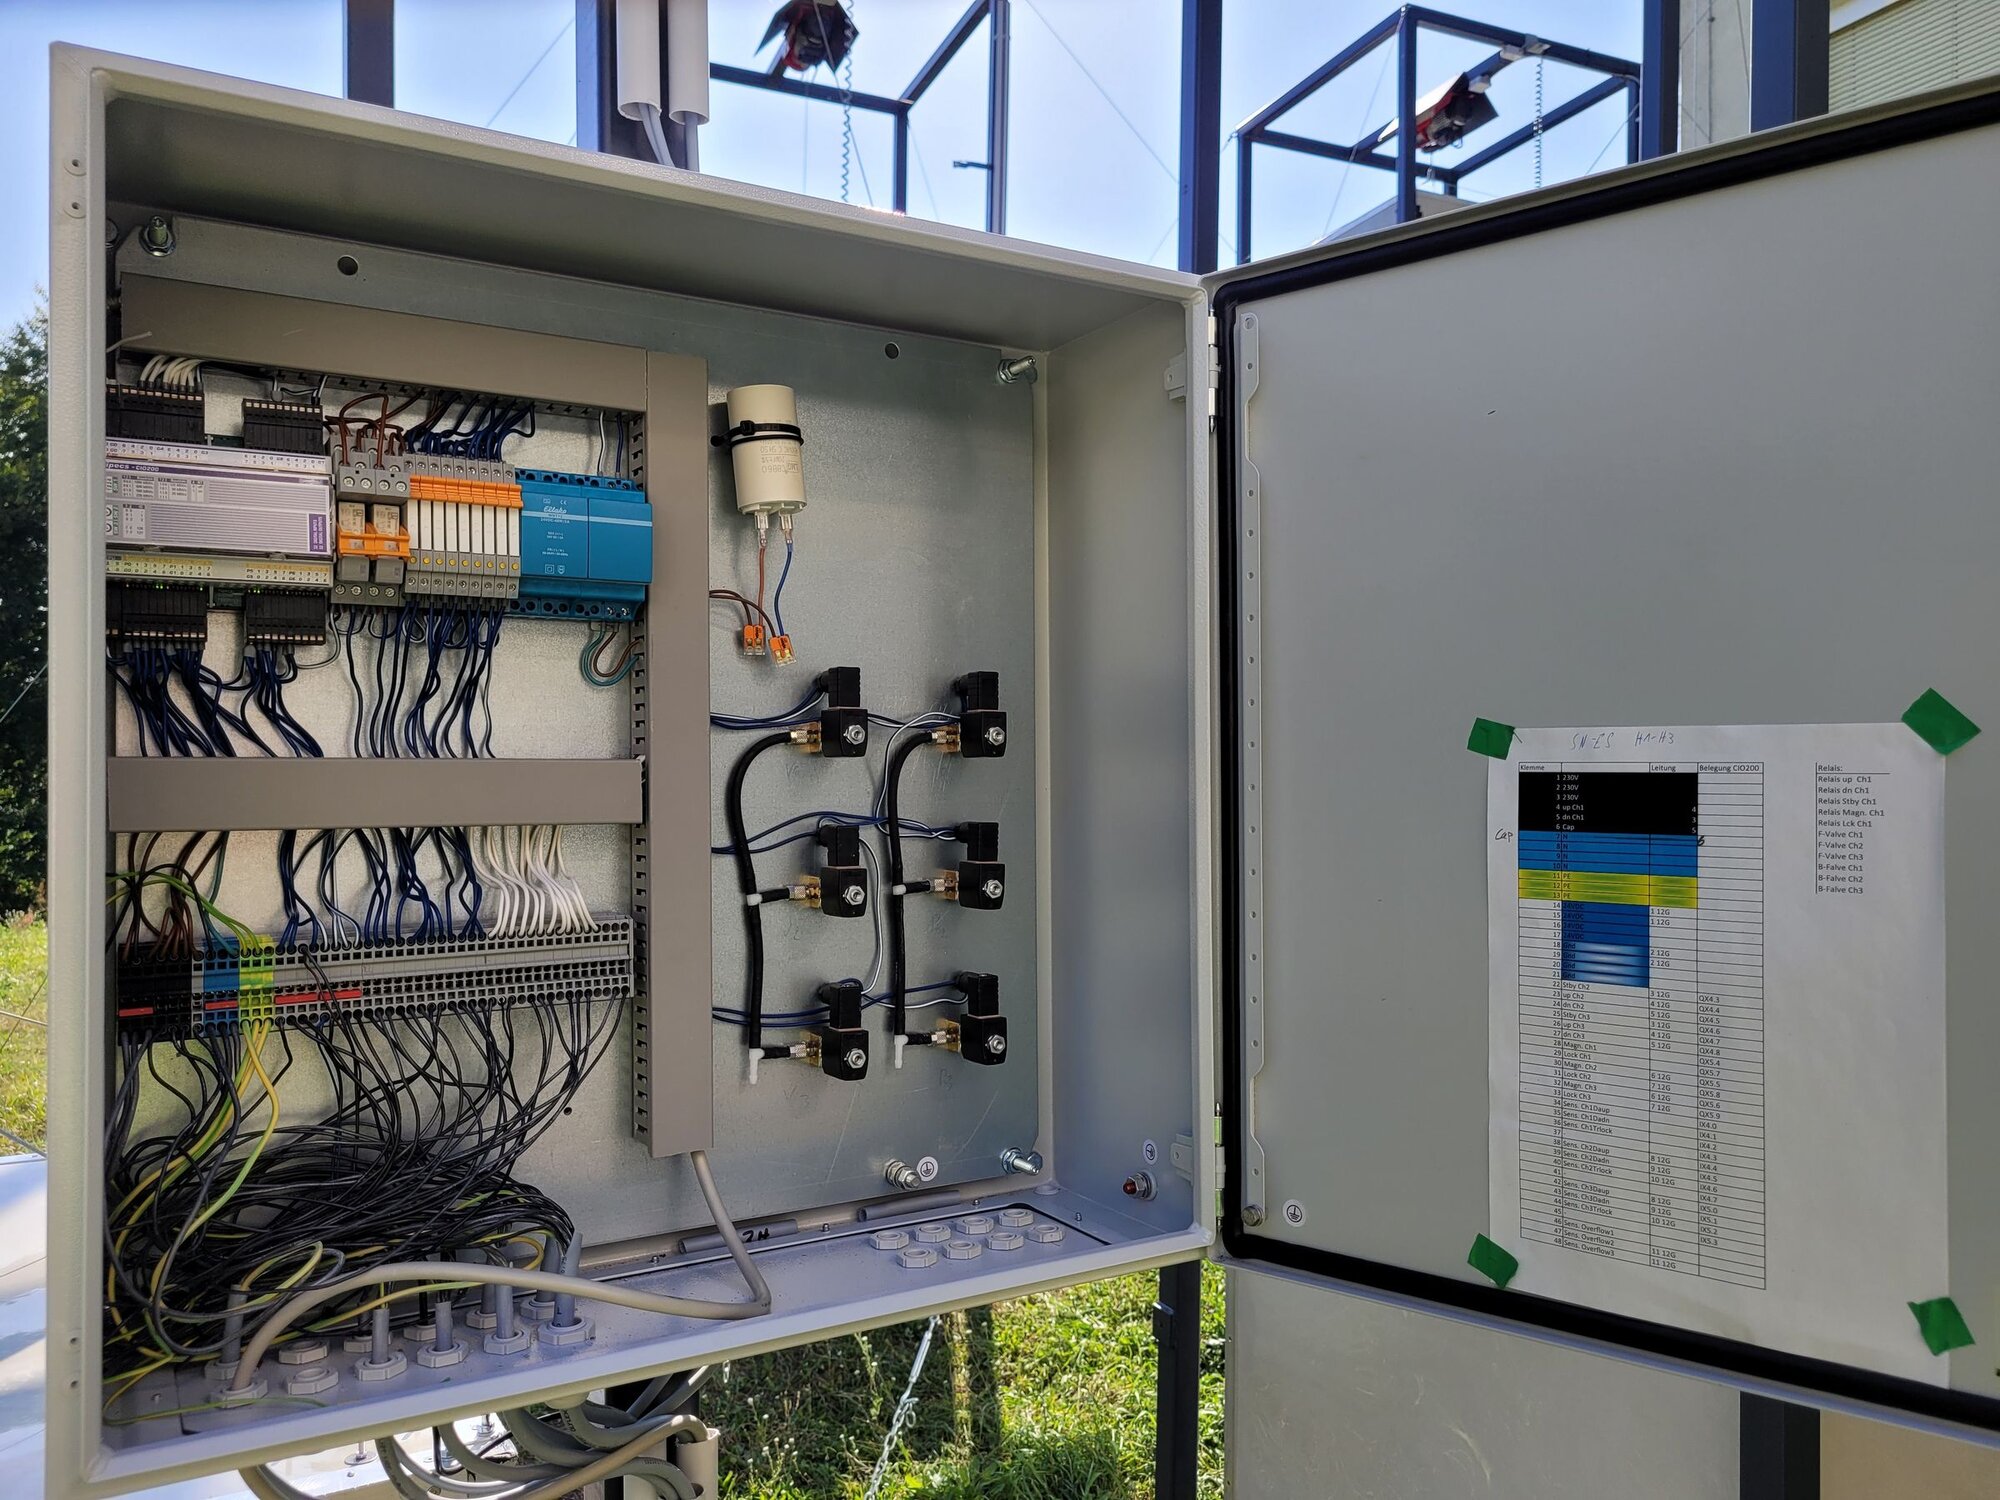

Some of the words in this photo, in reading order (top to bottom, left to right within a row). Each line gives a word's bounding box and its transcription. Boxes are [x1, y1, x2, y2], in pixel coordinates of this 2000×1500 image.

[1700, 764, 1730, 773] Belegung
[1842, 798, 1859, 806] Stby
[1564, 1041, 1583, 1050] Magn.
[1564, 1061, 1583, 1070] Magn.
[1699, 1058, 1720, 1066] QX5.4
[1699, 1068, 1720, 1077] QX5.7
[1564, 1081, 1583, 1090] Magn.
[1699, 1090, 1720, 1098] QX5.8
[1699, 1100, 1720, 1108] QX5.6
[1699, 1111, 1720, 1119] QX5.9
[1564, 1180, 1579, 1189] Sens.
[1564, 1200, 1580, 1208] Sens.
[1564, 1220, 1580, 1228] Sens.
[1564, 1240, 1580, 1249] Sens.
